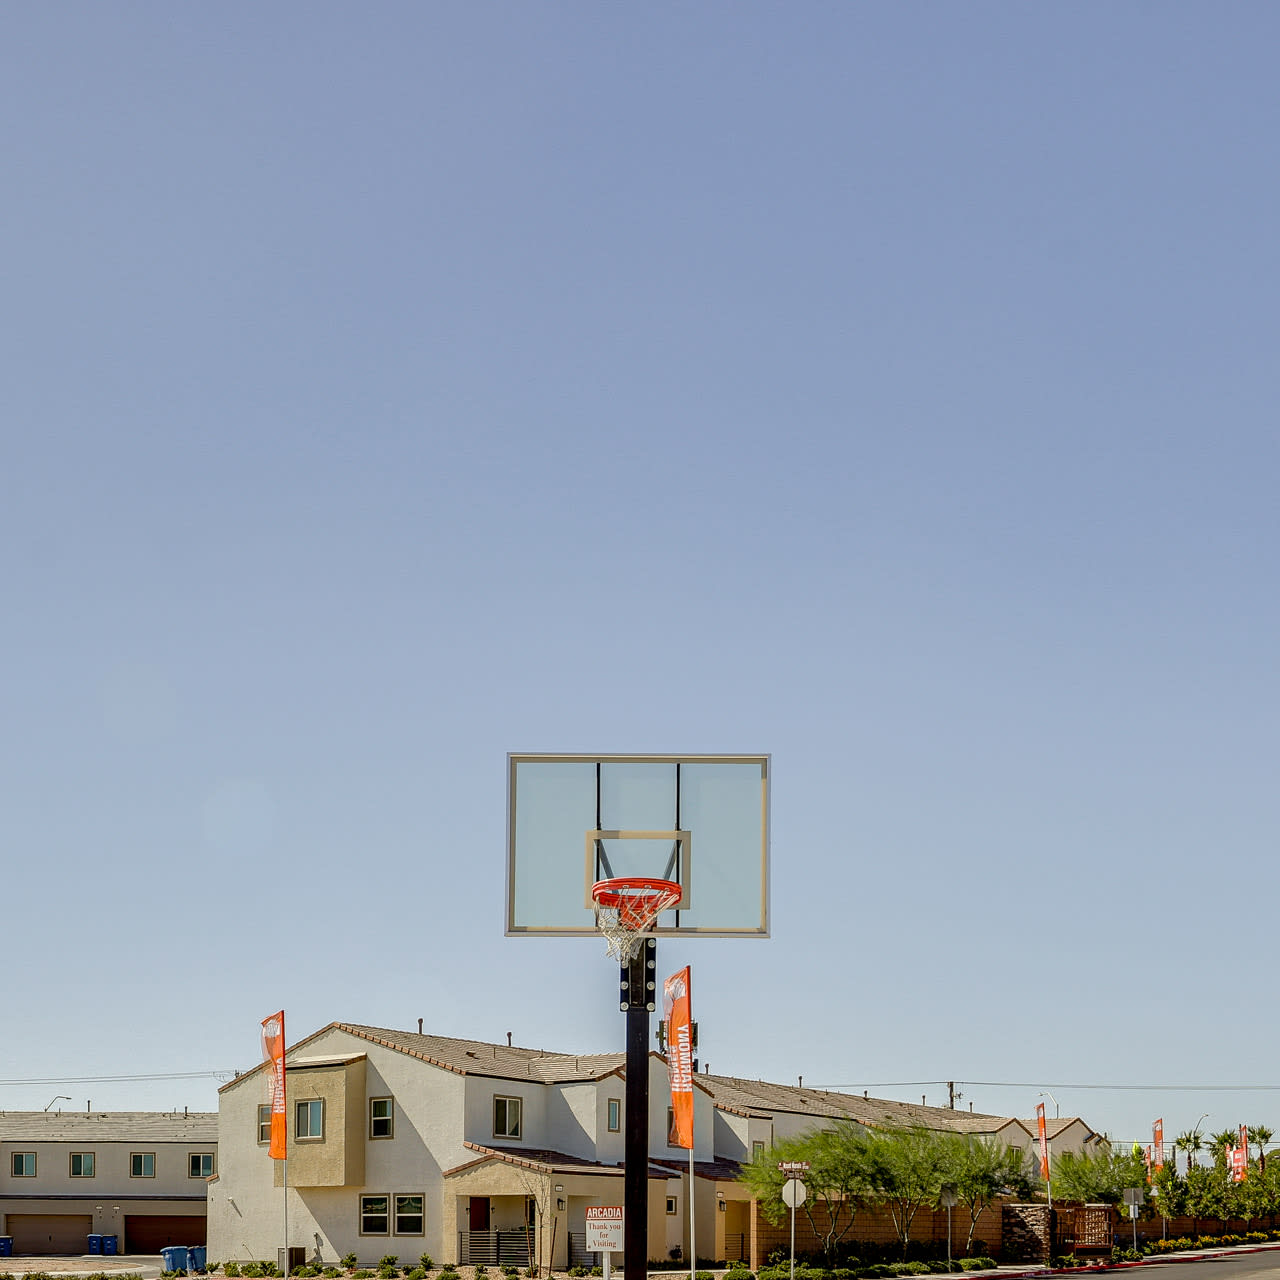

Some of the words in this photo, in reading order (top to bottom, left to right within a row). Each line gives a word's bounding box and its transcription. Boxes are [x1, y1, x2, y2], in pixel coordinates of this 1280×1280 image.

[587, 1207, 622, 1218] ARCADIA
[588, 1222, 608, 1230] Thank
[593, 1240, 617, 1248] Visiting
